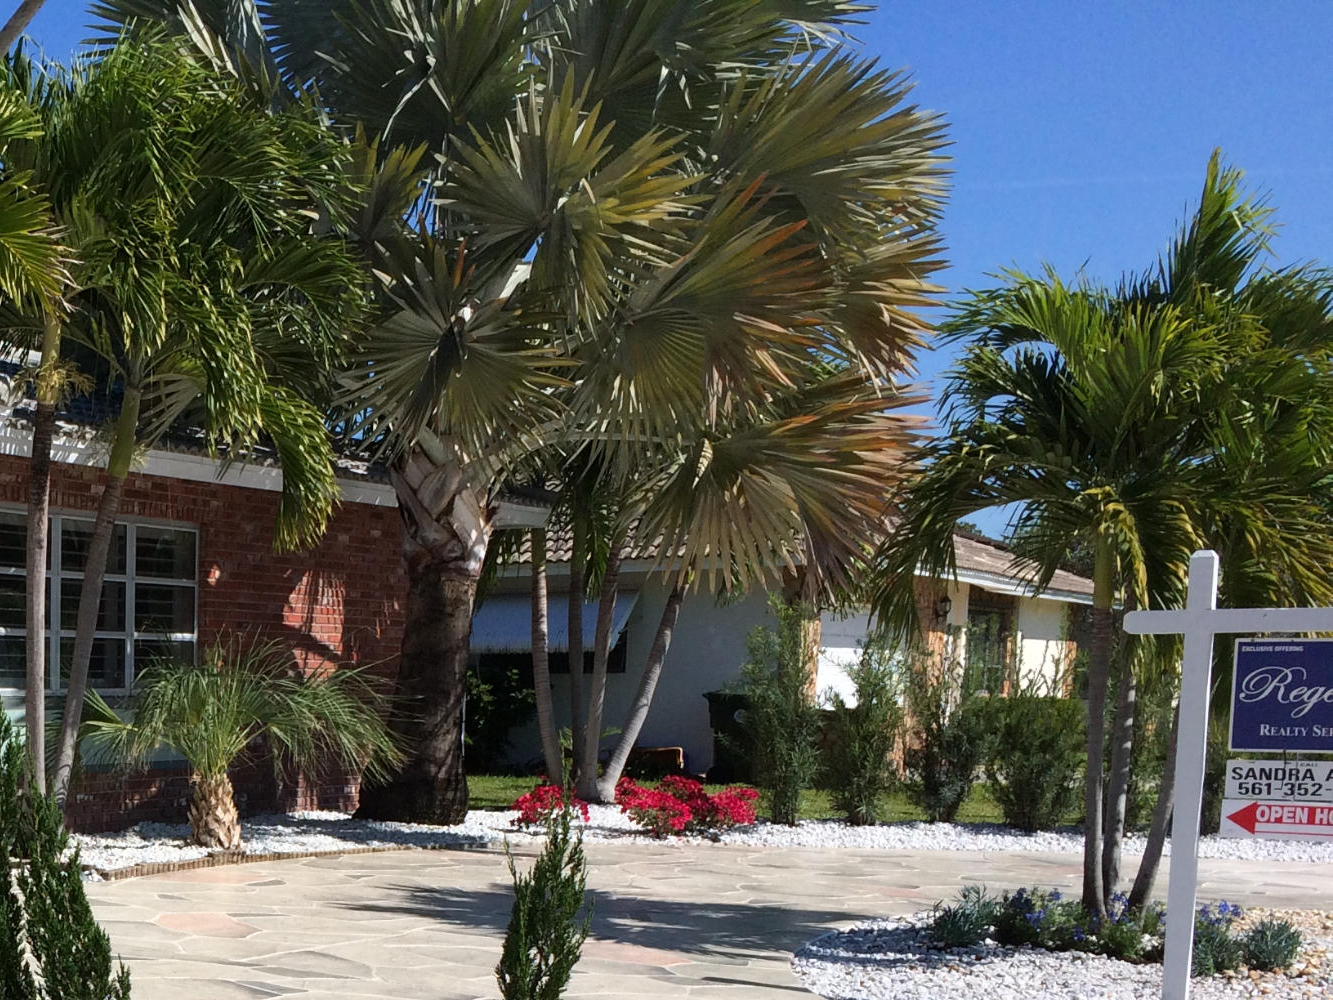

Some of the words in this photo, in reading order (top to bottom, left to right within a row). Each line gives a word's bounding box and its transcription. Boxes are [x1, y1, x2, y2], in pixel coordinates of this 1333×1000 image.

[1259, 724, 1308, 737] REALTY
[1231, 766, 1315, 781] SANDRA
[1255, 805, 1308, 823] OPEN
